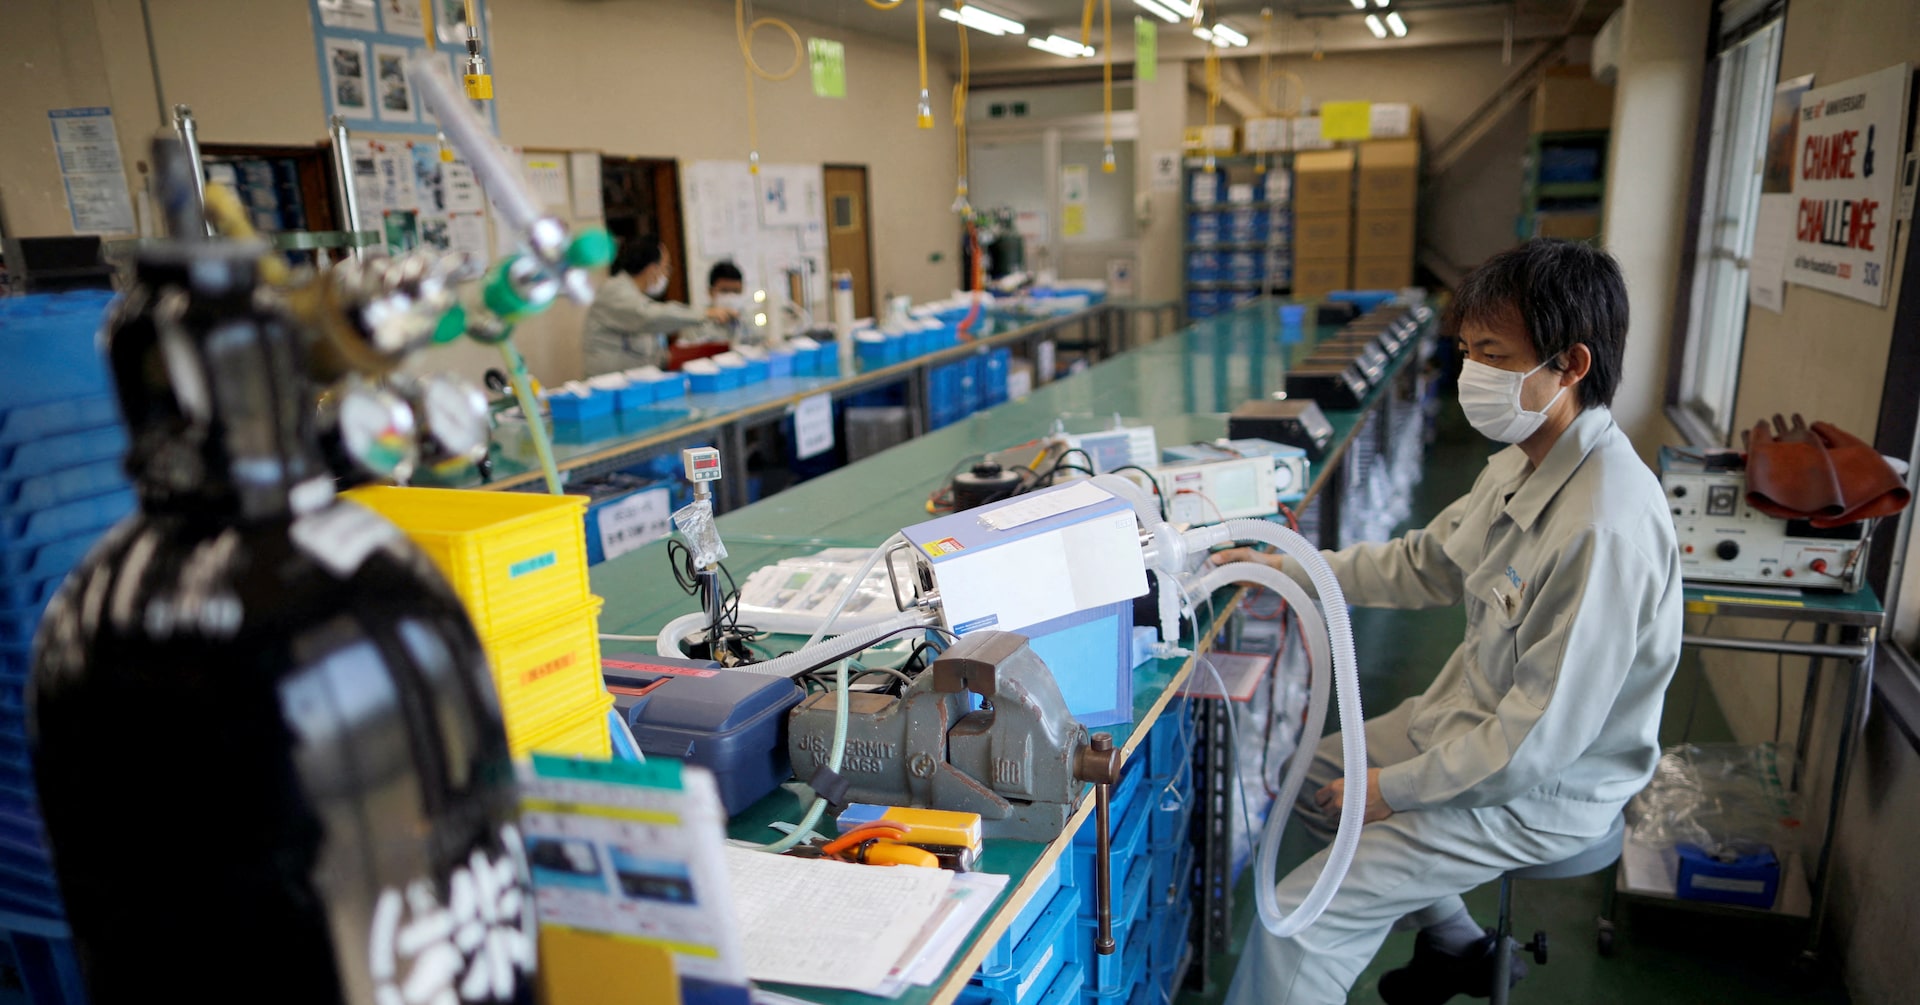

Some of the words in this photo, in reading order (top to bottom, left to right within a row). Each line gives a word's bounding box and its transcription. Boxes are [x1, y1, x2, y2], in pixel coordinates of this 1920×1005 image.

[1802, 130, 1858, 180] CHANGE
[1863, 124, 1875, 178] &
[1797, 197, 1879, 252] CHALLENGE
[844, 738, 896, 760] ERMIT
